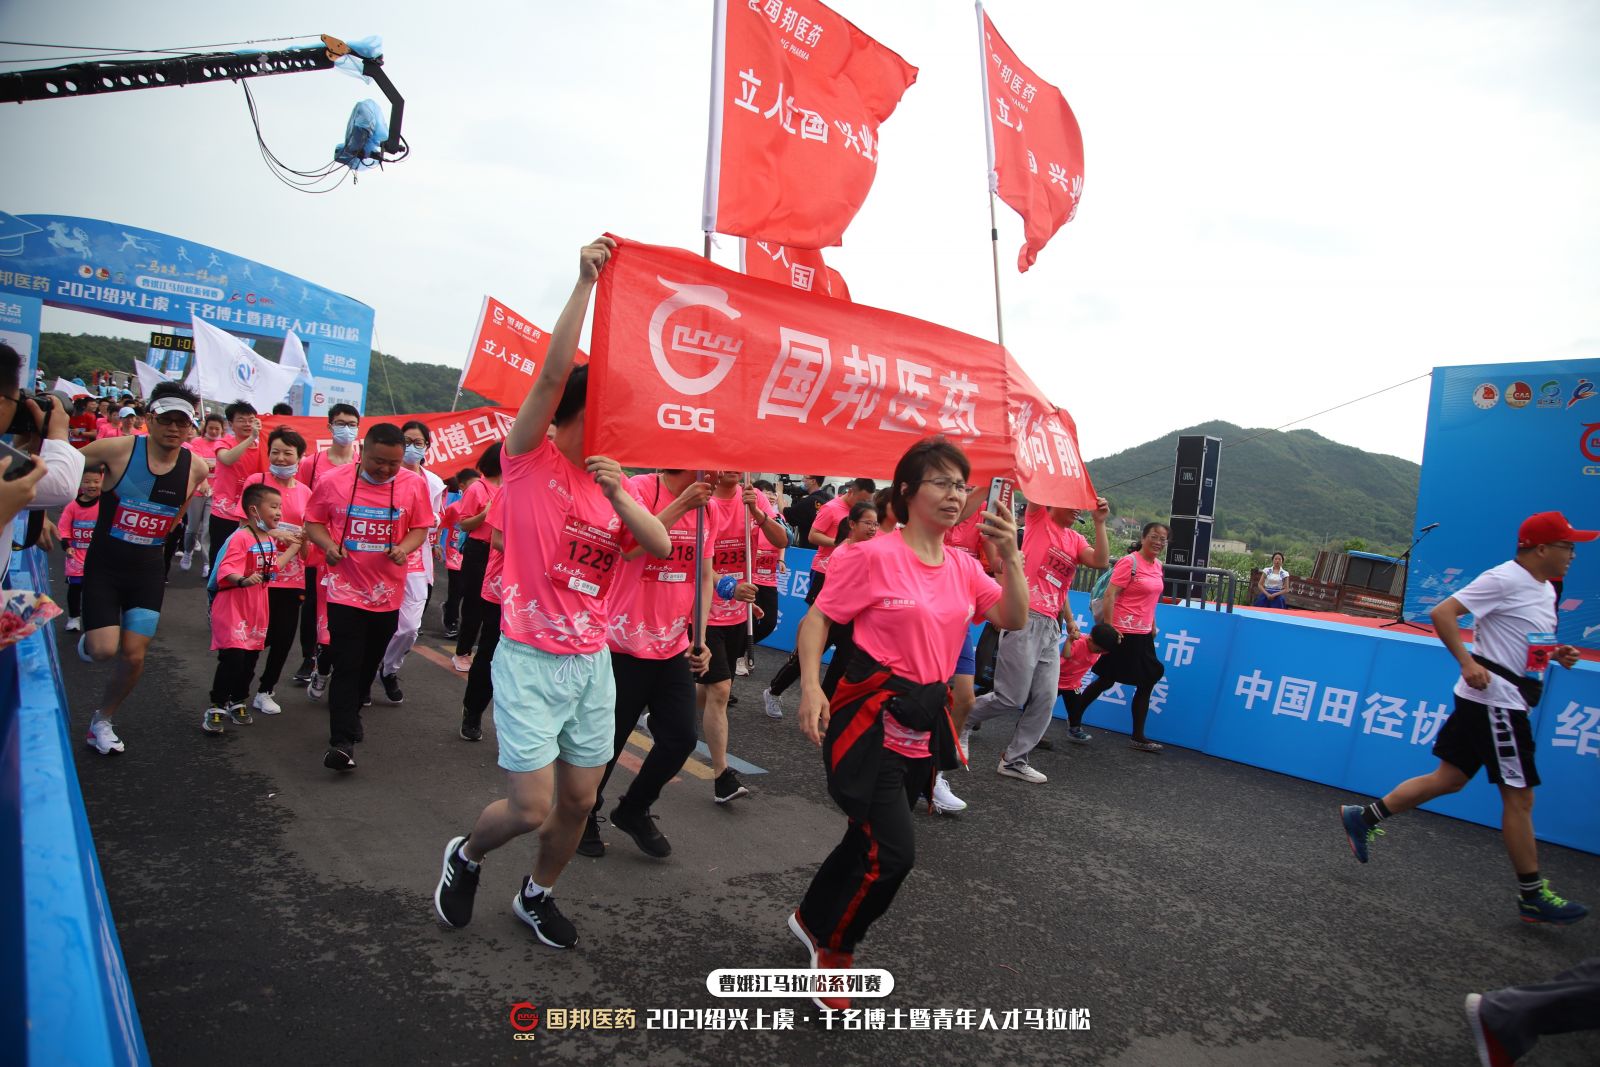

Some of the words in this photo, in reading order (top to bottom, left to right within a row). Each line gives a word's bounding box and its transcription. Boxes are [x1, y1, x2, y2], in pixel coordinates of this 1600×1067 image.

[764, 0, 824, 48] 国邦医药
[153, 335, 195, 351] 0:01:0
[481, 339, 536, 377] 立人立国
[757, 327, 981, 438] 国邦医药
[568, 540, 615, 572] 1229
[657, 545, 694, 563] 218
